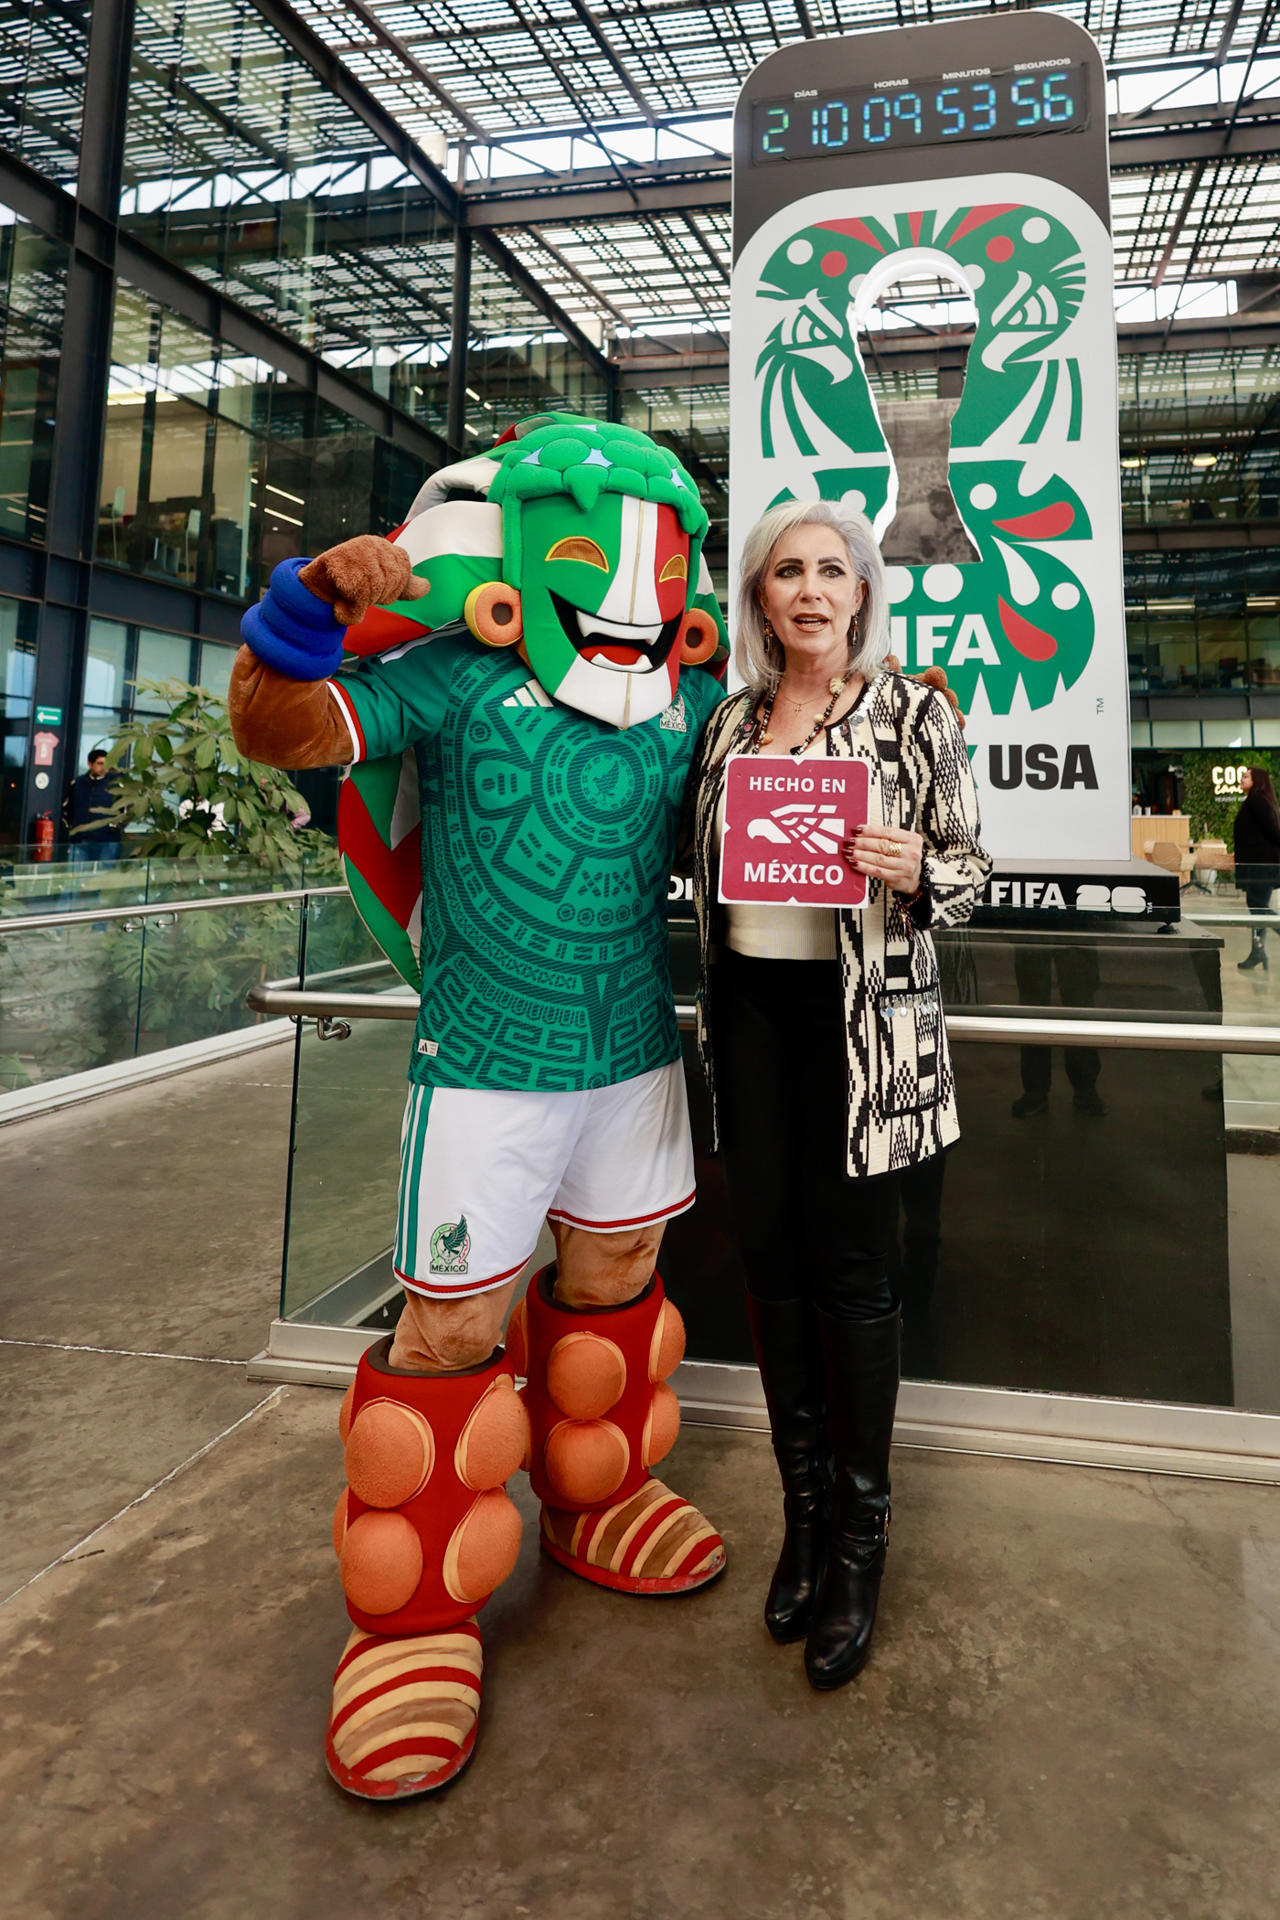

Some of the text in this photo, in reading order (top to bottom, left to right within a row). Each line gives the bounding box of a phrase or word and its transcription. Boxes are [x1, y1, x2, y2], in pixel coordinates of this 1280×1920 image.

[794, 57, 1071, 98] DÍAS HORAS MINUTOS SEGUNDOS
[863, 92, 921, 143] 09
[936, 83, 996, 135] 53
[1010, 73, 1073, 126] 56
[890, 613, 1001, 667] IFA
[749, 776, 846, 794] HECHO EN
[989, 743, 1099, 791] USA
[744, 859, 844, 886] MÉXICO
[991, 881, 1067, 910] FIFA
